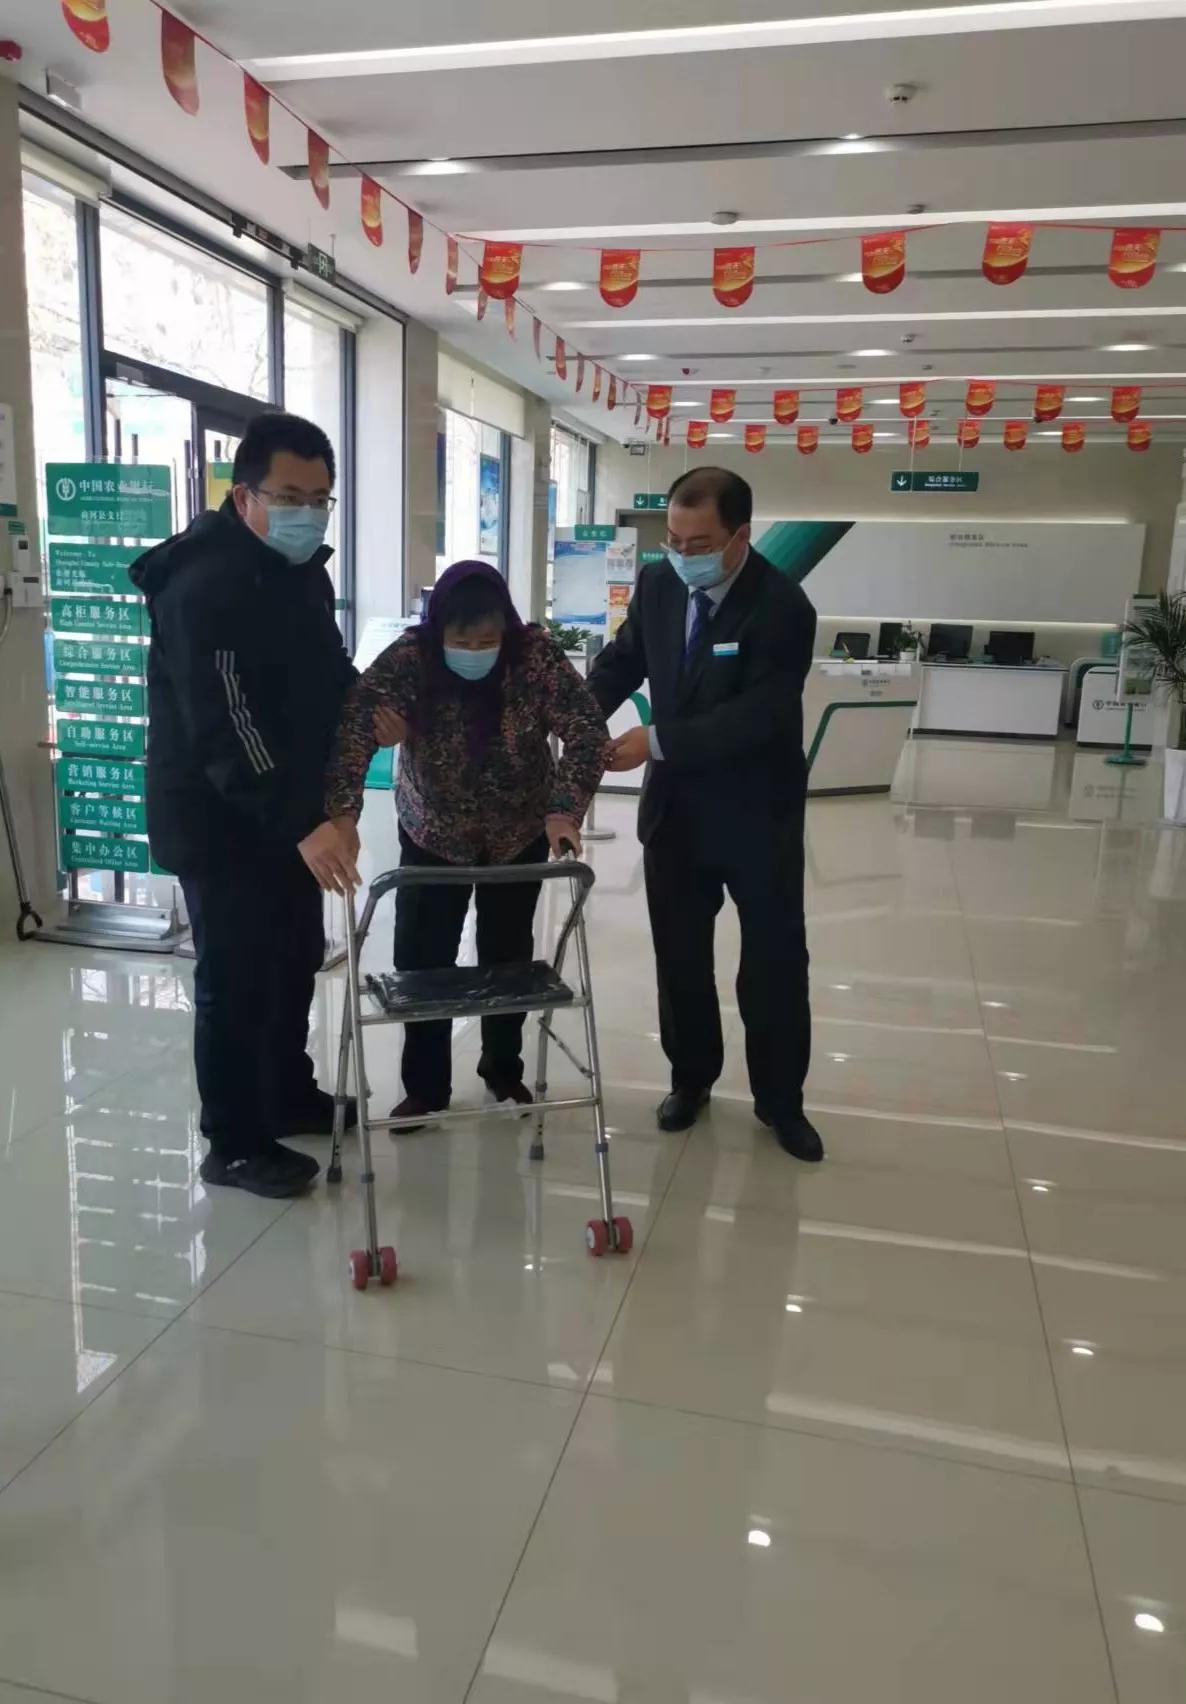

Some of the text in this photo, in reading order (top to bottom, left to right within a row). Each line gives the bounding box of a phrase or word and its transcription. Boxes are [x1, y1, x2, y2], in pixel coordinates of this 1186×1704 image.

[61, 604, 130, 620] 高柜服务区
[63, 646, 131, 661] 综合服务区
[64, 686, 133, 702] 智能服务区
[67, 726, 134, 742] 自助服务区
[68, 764, 134, 780] 营销服务区
[72, 841, 138, 859] 集中办公区
